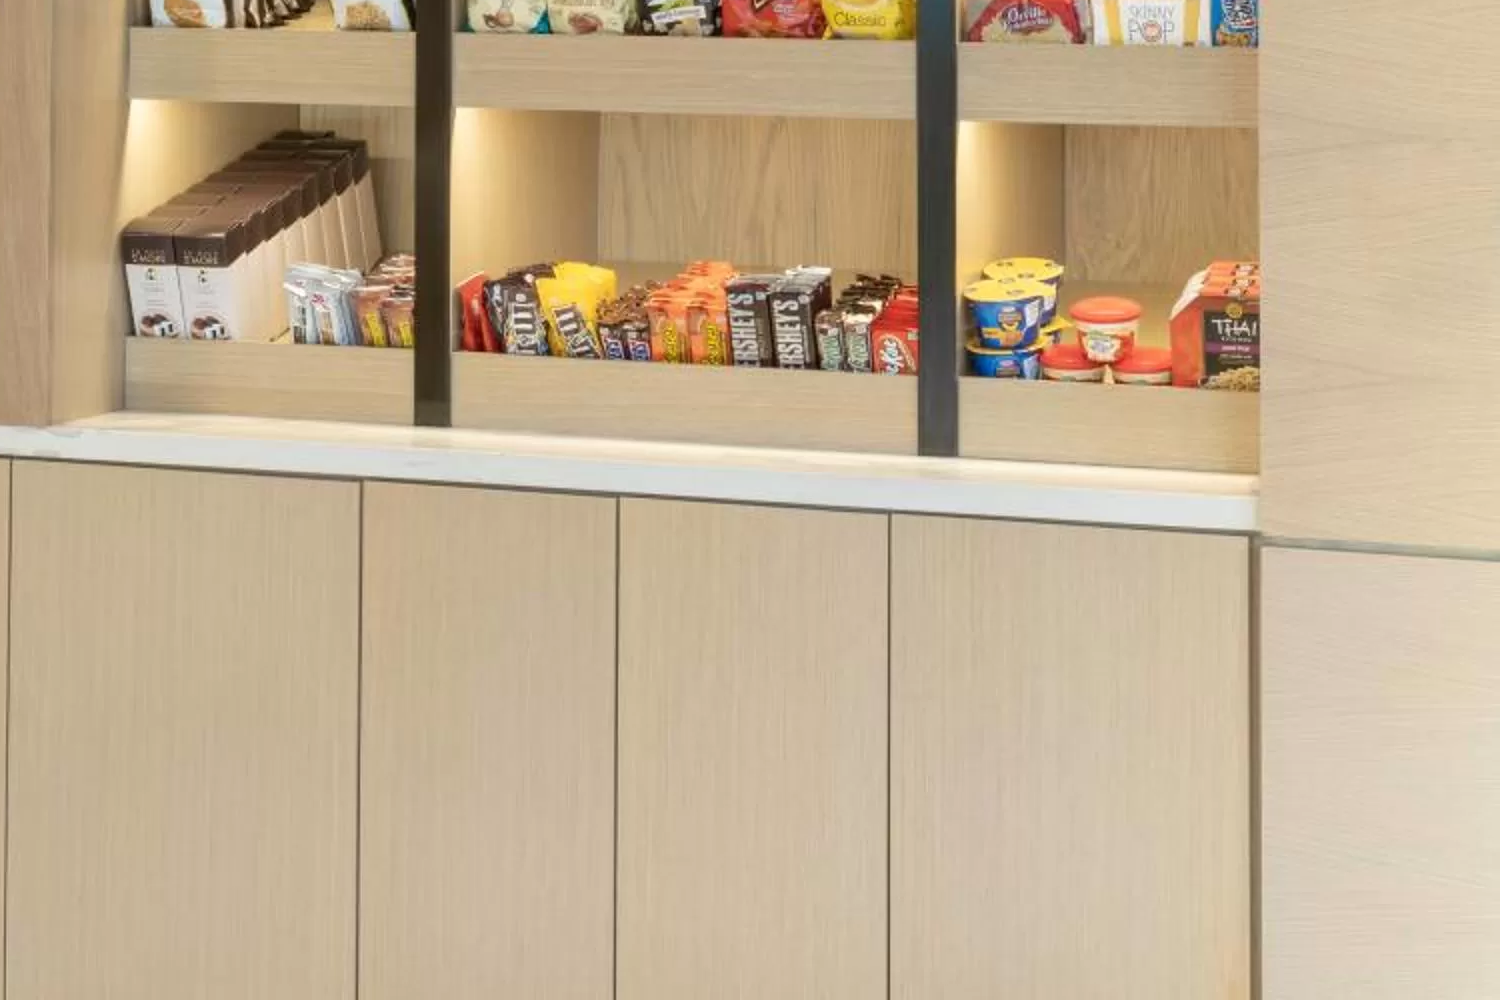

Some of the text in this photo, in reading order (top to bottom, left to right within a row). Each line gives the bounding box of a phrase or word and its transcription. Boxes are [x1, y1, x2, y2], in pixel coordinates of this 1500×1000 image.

[833, 10, 888, 28] Classic
[1127, 4, 1176, 19] SKINNY
[1211, 318, 1257, 337] THAI
